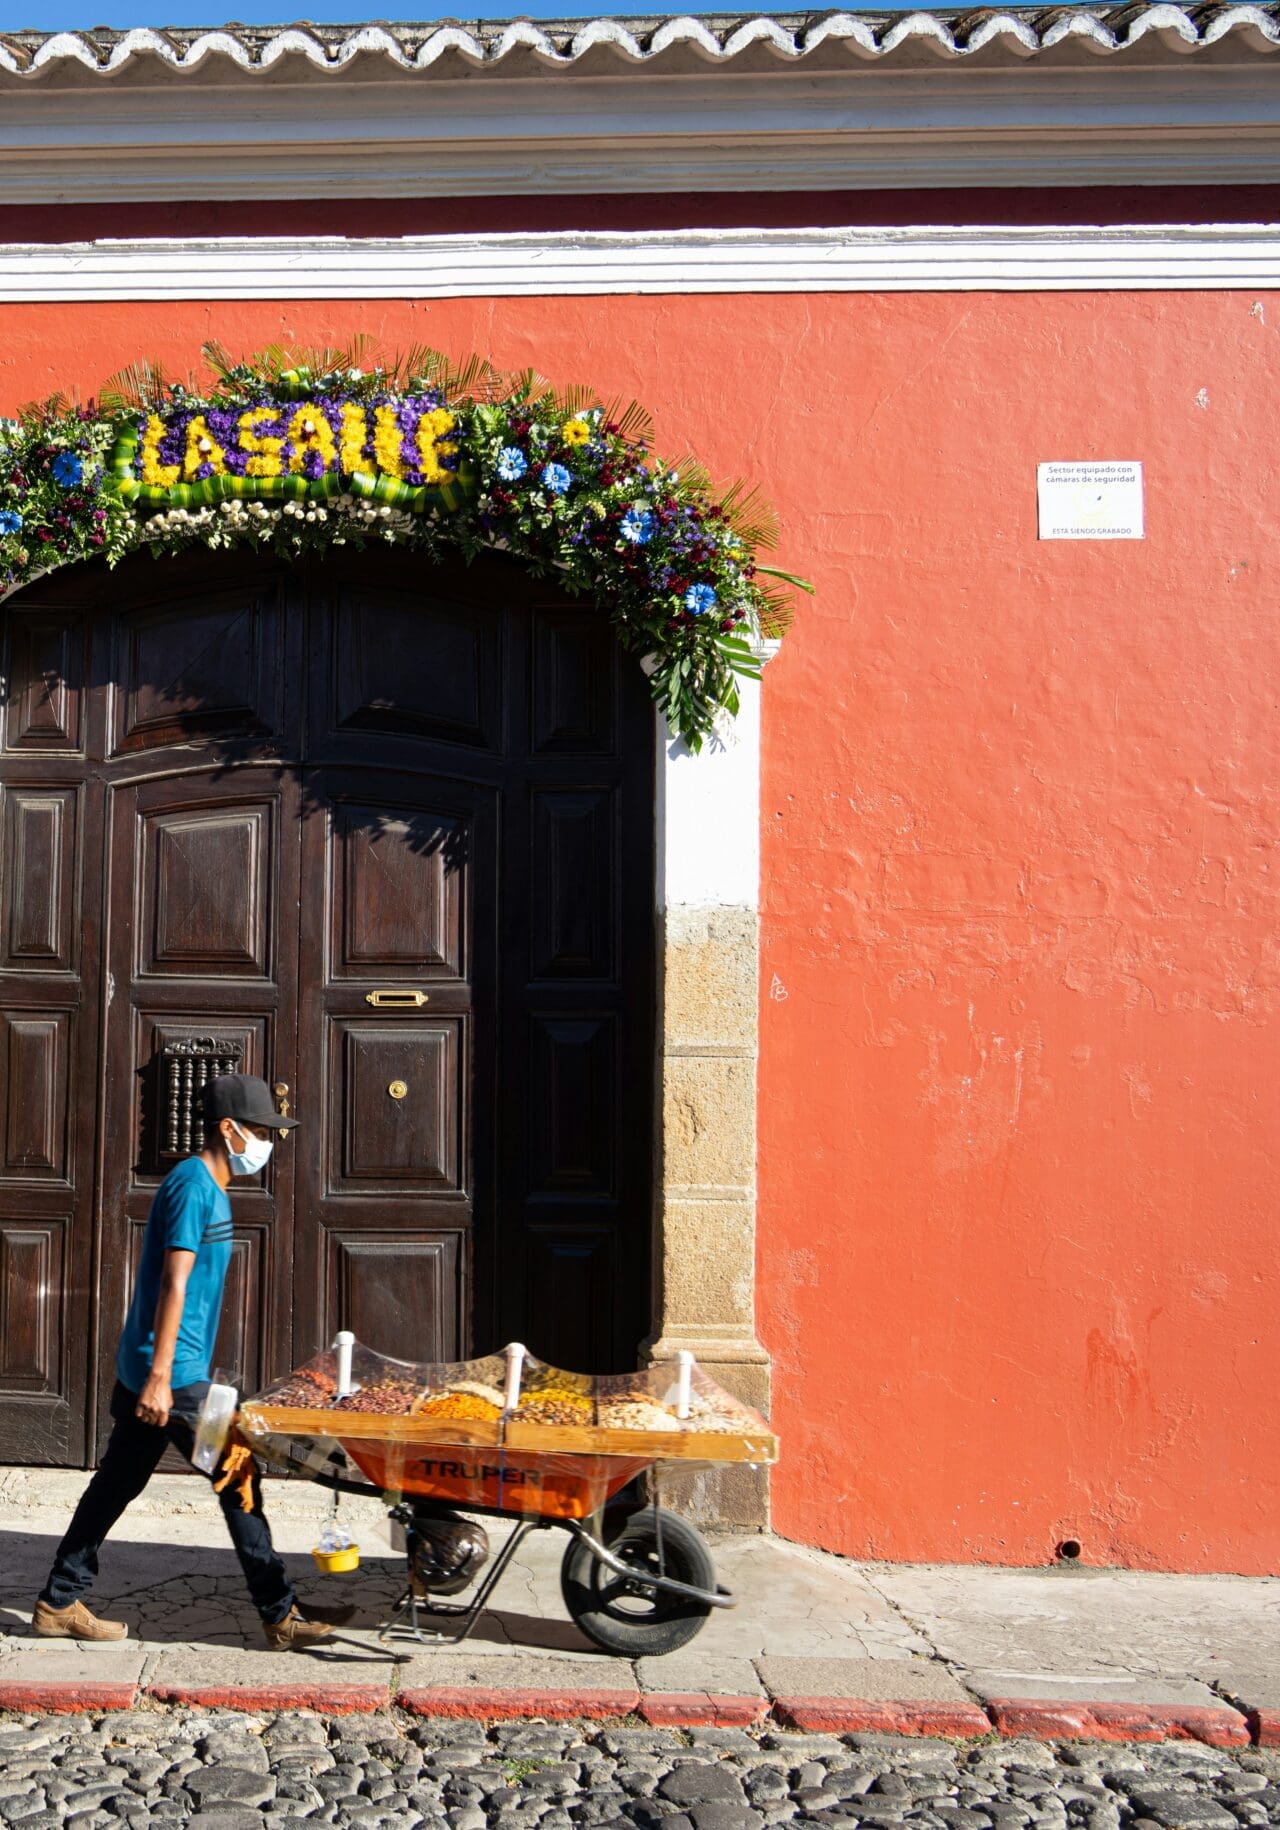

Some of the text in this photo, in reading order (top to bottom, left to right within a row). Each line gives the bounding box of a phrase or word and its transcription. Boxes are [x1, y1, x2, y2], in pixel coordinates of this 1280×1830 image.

[1048, 466, 1075, 474] Sector
[1076, 466, 1116, 474] equipado
[1094, 475, 1136, 484] seguridad
[419, 1459, 540, 1485] TRUPER
